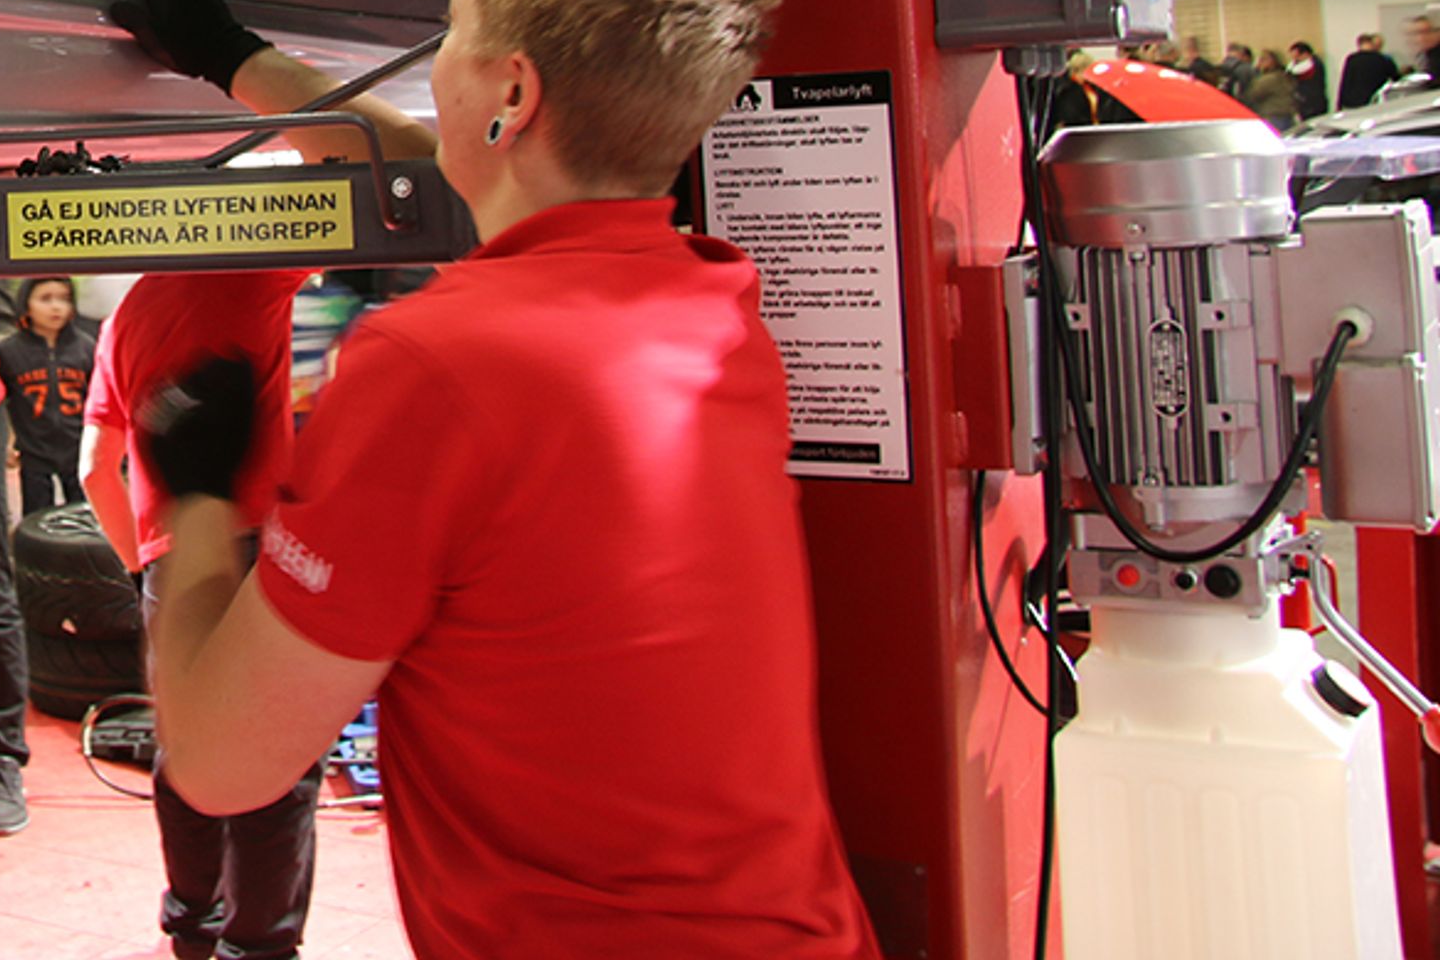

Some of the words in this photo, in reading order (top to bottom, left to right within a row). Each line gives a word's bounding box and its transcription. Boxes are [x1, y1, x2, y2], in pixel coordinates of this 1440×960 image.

[22, 198, 54, 221] GÅ
[59, 202, 83, 221] EJ
[88, 199, 168, 220] UNDER
[174, 195, 257, 216] LYFTEN
[263, 192, 337, 213] INNAN
[22, 226, 169, 248] SPÄRRARNA
[175, 222, 209, 243] ÄR
[216, 224, 222, 242] I
[230, 220, 338, 241] INGREPP
[23, 381, 83, 419] 75
